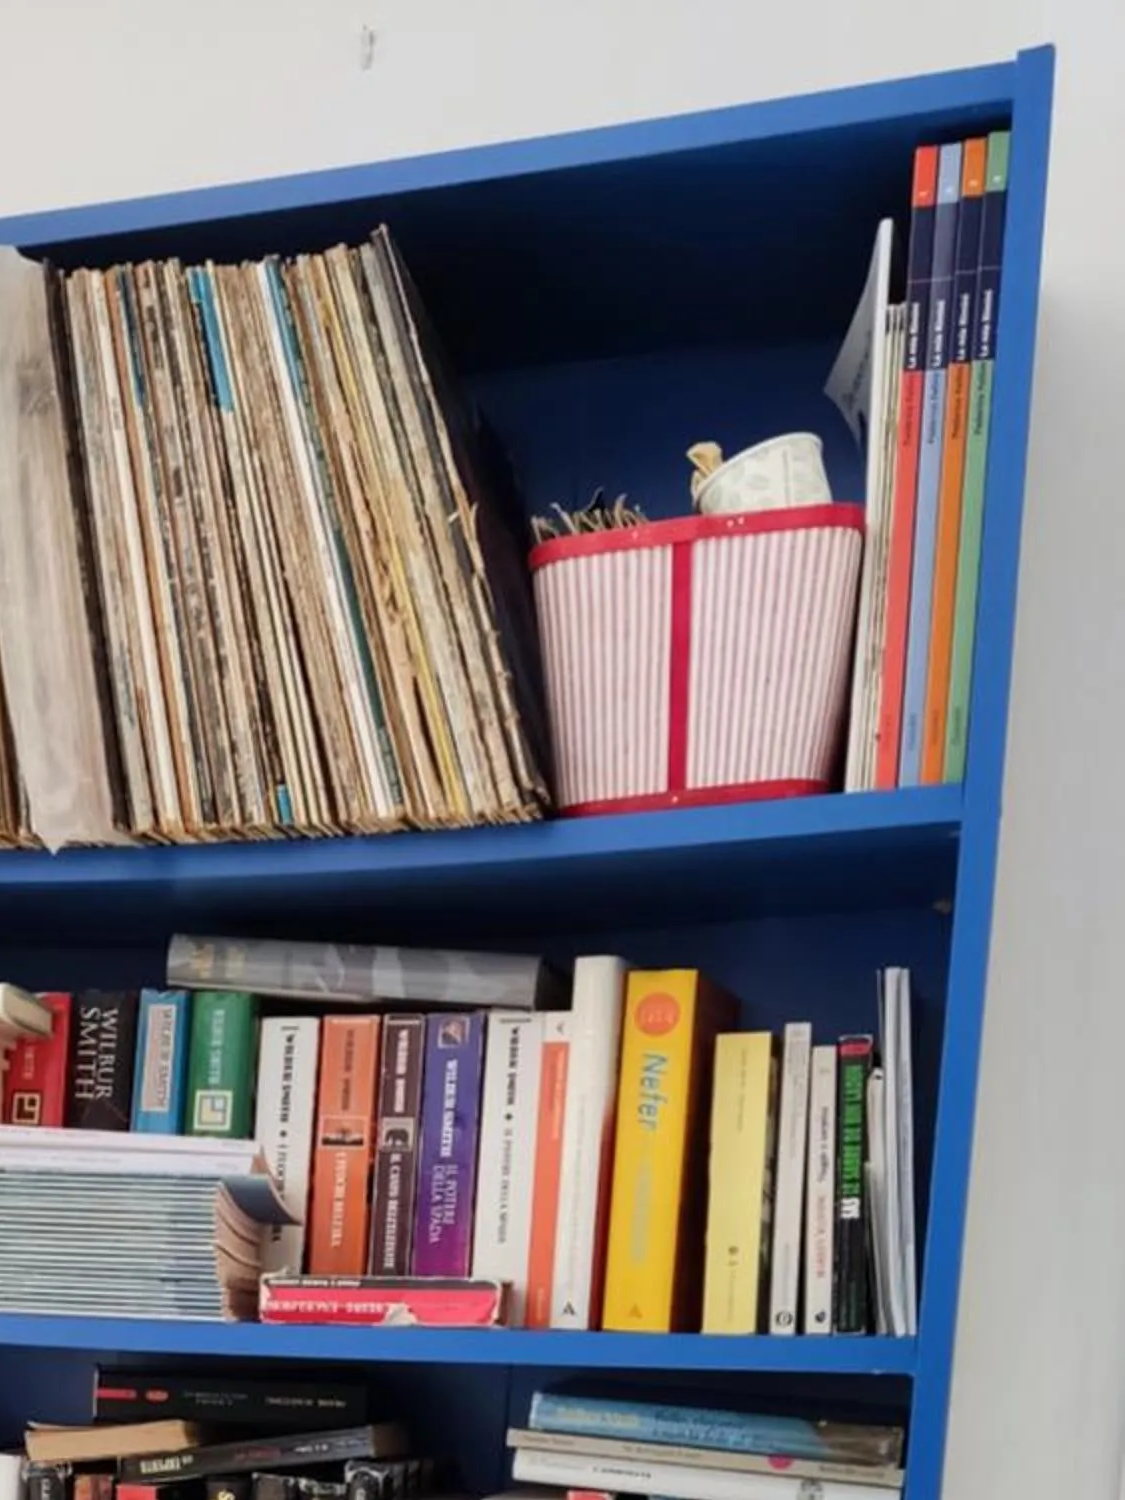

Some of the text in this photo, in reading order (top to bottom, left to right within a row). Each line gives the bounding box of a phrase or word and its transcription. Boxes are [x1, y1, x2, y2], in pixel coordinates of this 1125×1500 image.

[74, 1007, 119, 1100] WILBUR SMITH
[638, 1054, 668, 1132] Nefer
[440, 1059, 458, 1158] WILBUR SMITH
